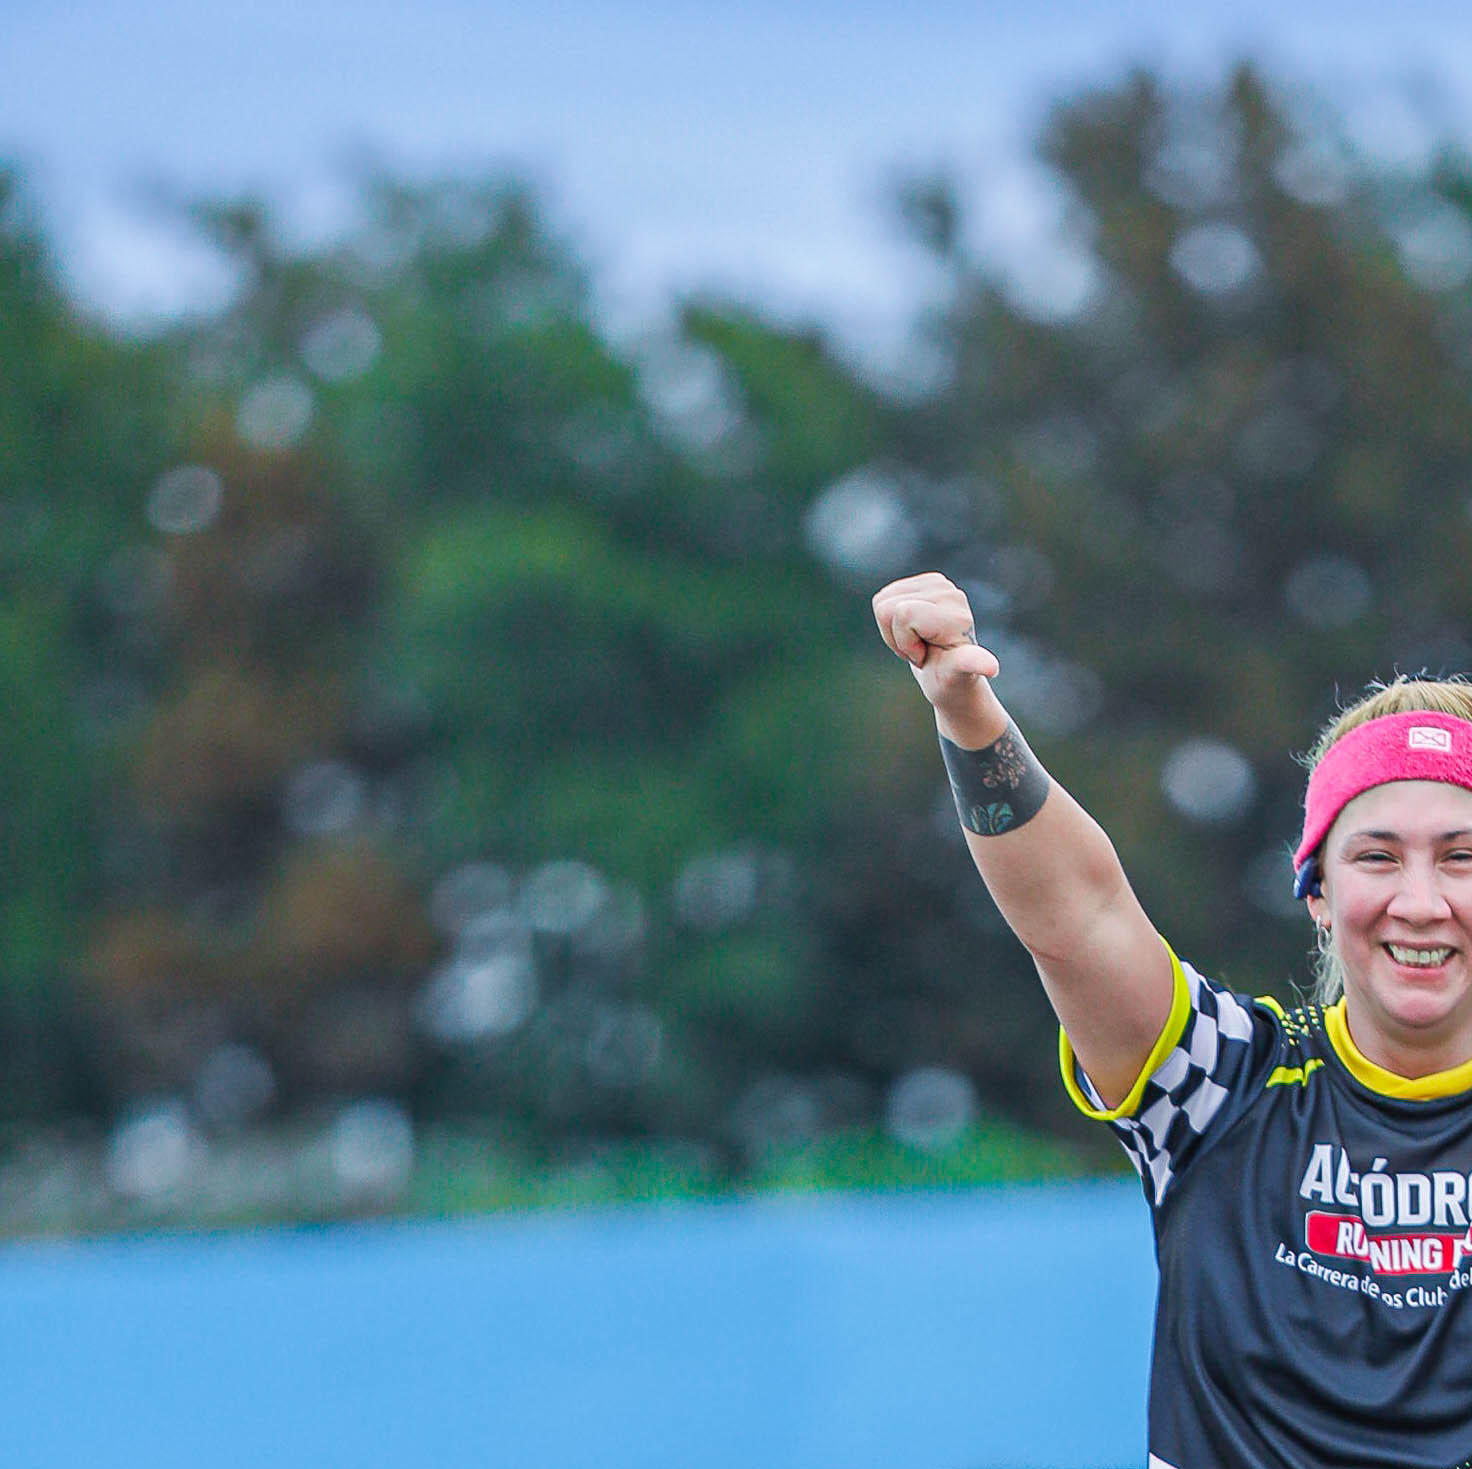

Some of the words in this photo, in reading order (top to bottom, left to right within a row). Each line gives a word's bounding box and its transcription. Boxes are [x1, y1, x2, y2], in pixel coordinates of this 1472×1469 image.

[1274, 1241, 1296, 1267] La
[1298, 1251, 1360, 1292] Carrera
[1360, 1274, 1381, 1300] de
[1381, 1291, 1404, 1310] os
[1335, 1220, 1443, 1272] RUNING
